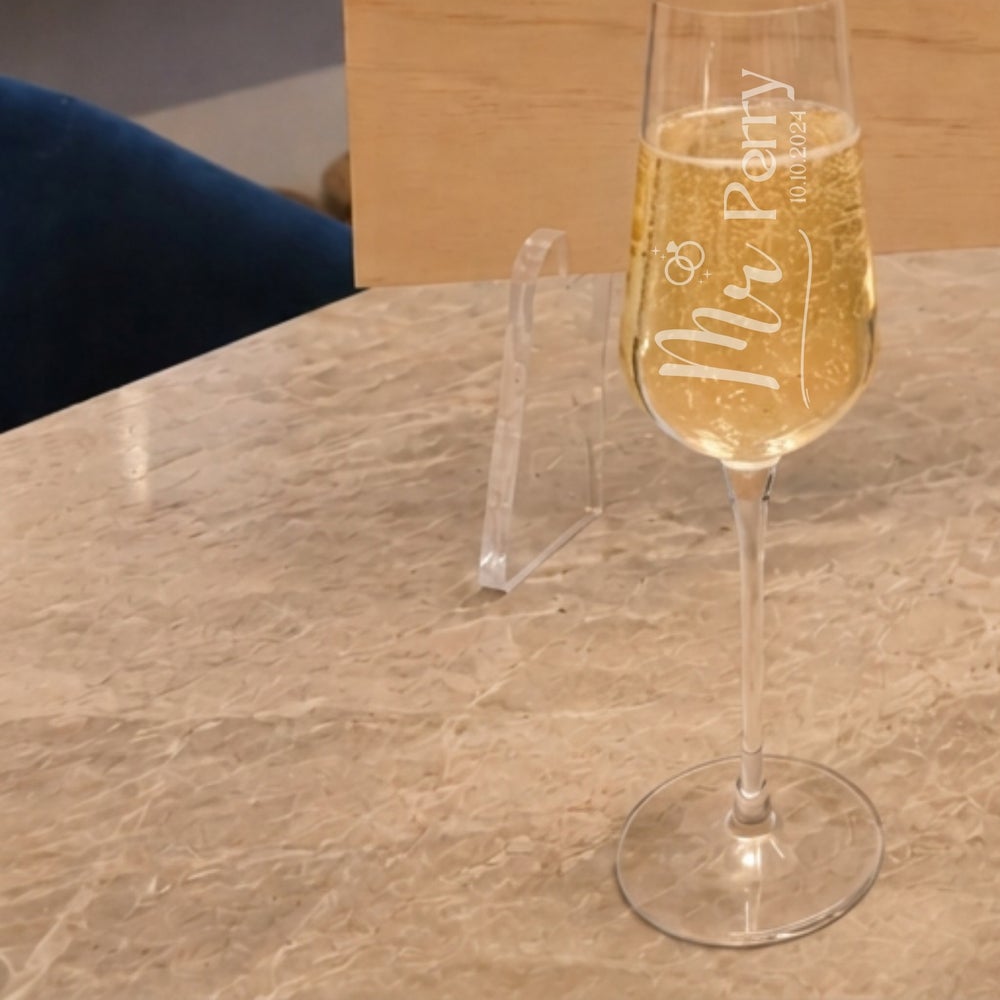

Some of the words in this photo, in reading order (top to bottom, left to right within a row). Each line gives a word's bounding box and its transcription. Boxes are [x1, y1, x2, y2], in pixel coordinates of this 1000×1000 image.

[654, 242, 783, 391] Mr
[723, 68, 795, 221] Perry
[789, 110, 807, 204] 10.10.2024
